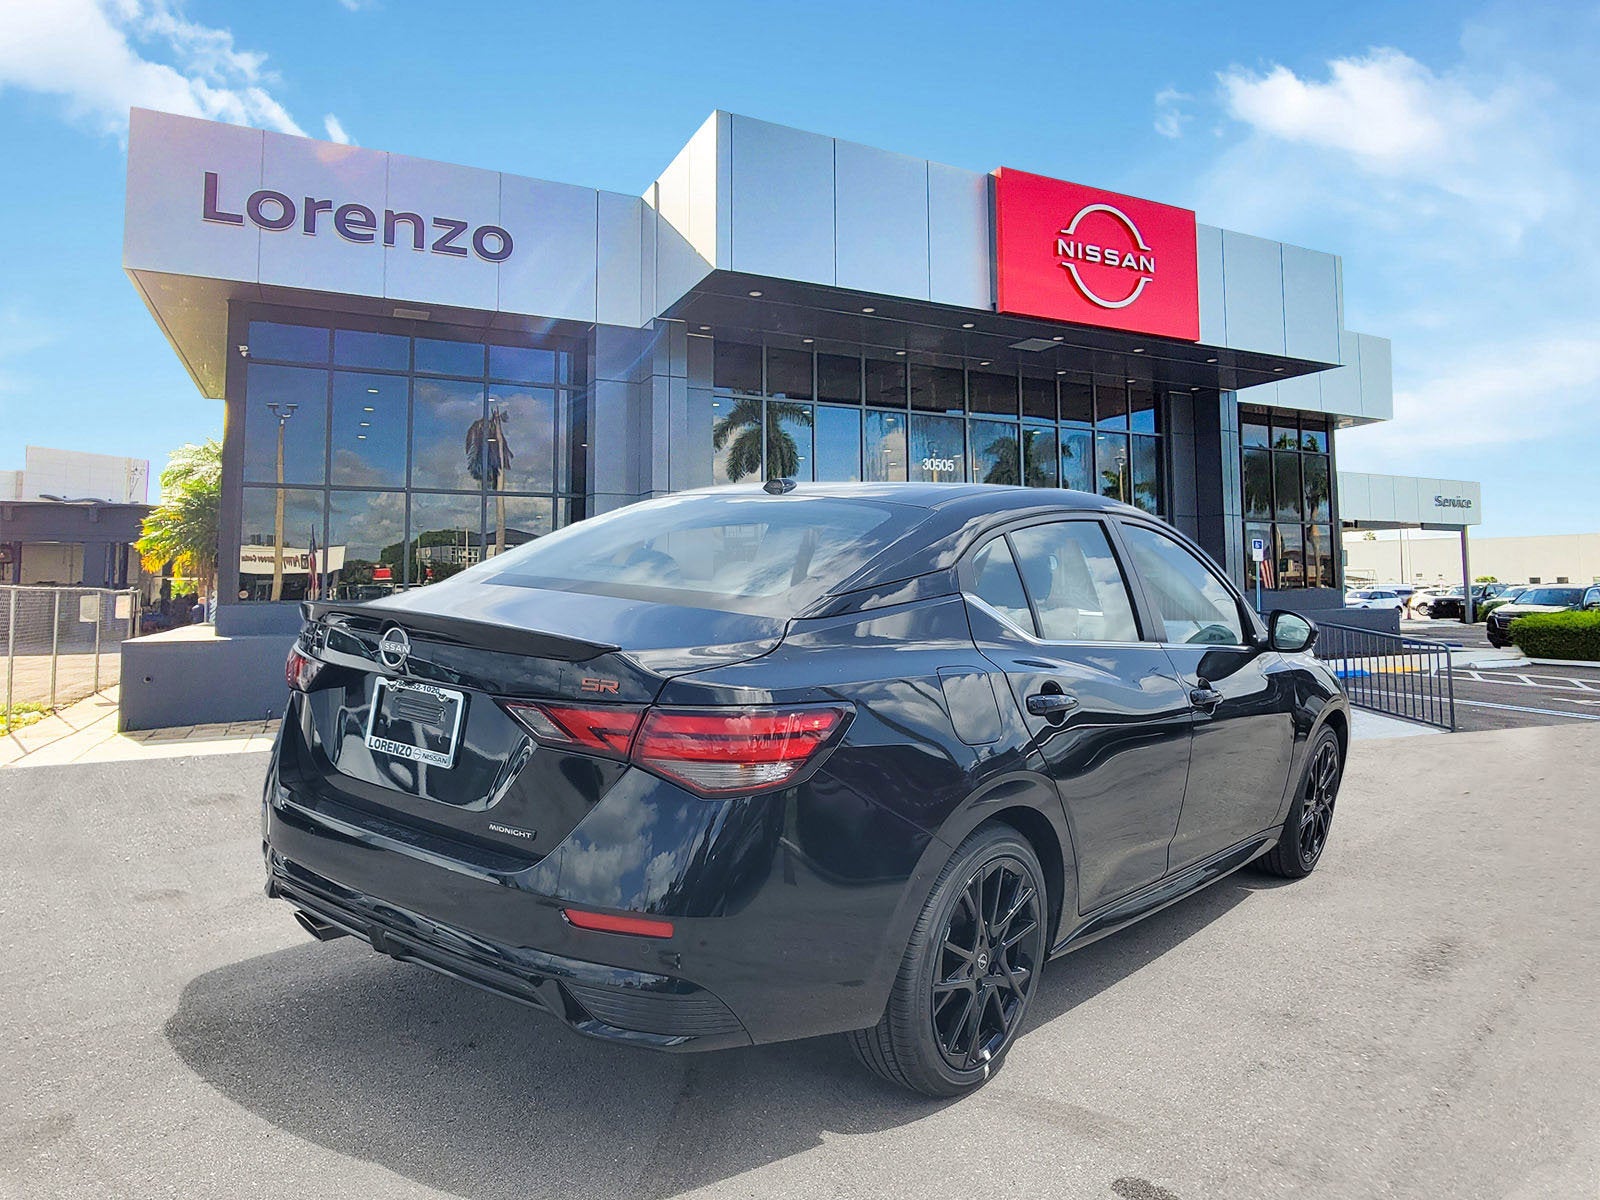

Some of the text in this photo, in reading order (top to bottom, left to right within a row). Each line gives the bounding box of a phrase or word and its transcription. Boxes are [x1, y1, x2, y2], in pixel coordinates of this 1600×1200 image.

[202, 171, 514, 262] Lorenzo
[1057, 238, 1155, 273] NISSAN
[922, 458, 954, 471] 30505
[1434, 495, 1472, 509] Service
[380, 641, 410, 654] SSAN
[581, 678, 620, 694] SR
[368, 737, 448, 765] LORENZO NISSAN
[489, 823, 532, 839] MIDNIGHT
